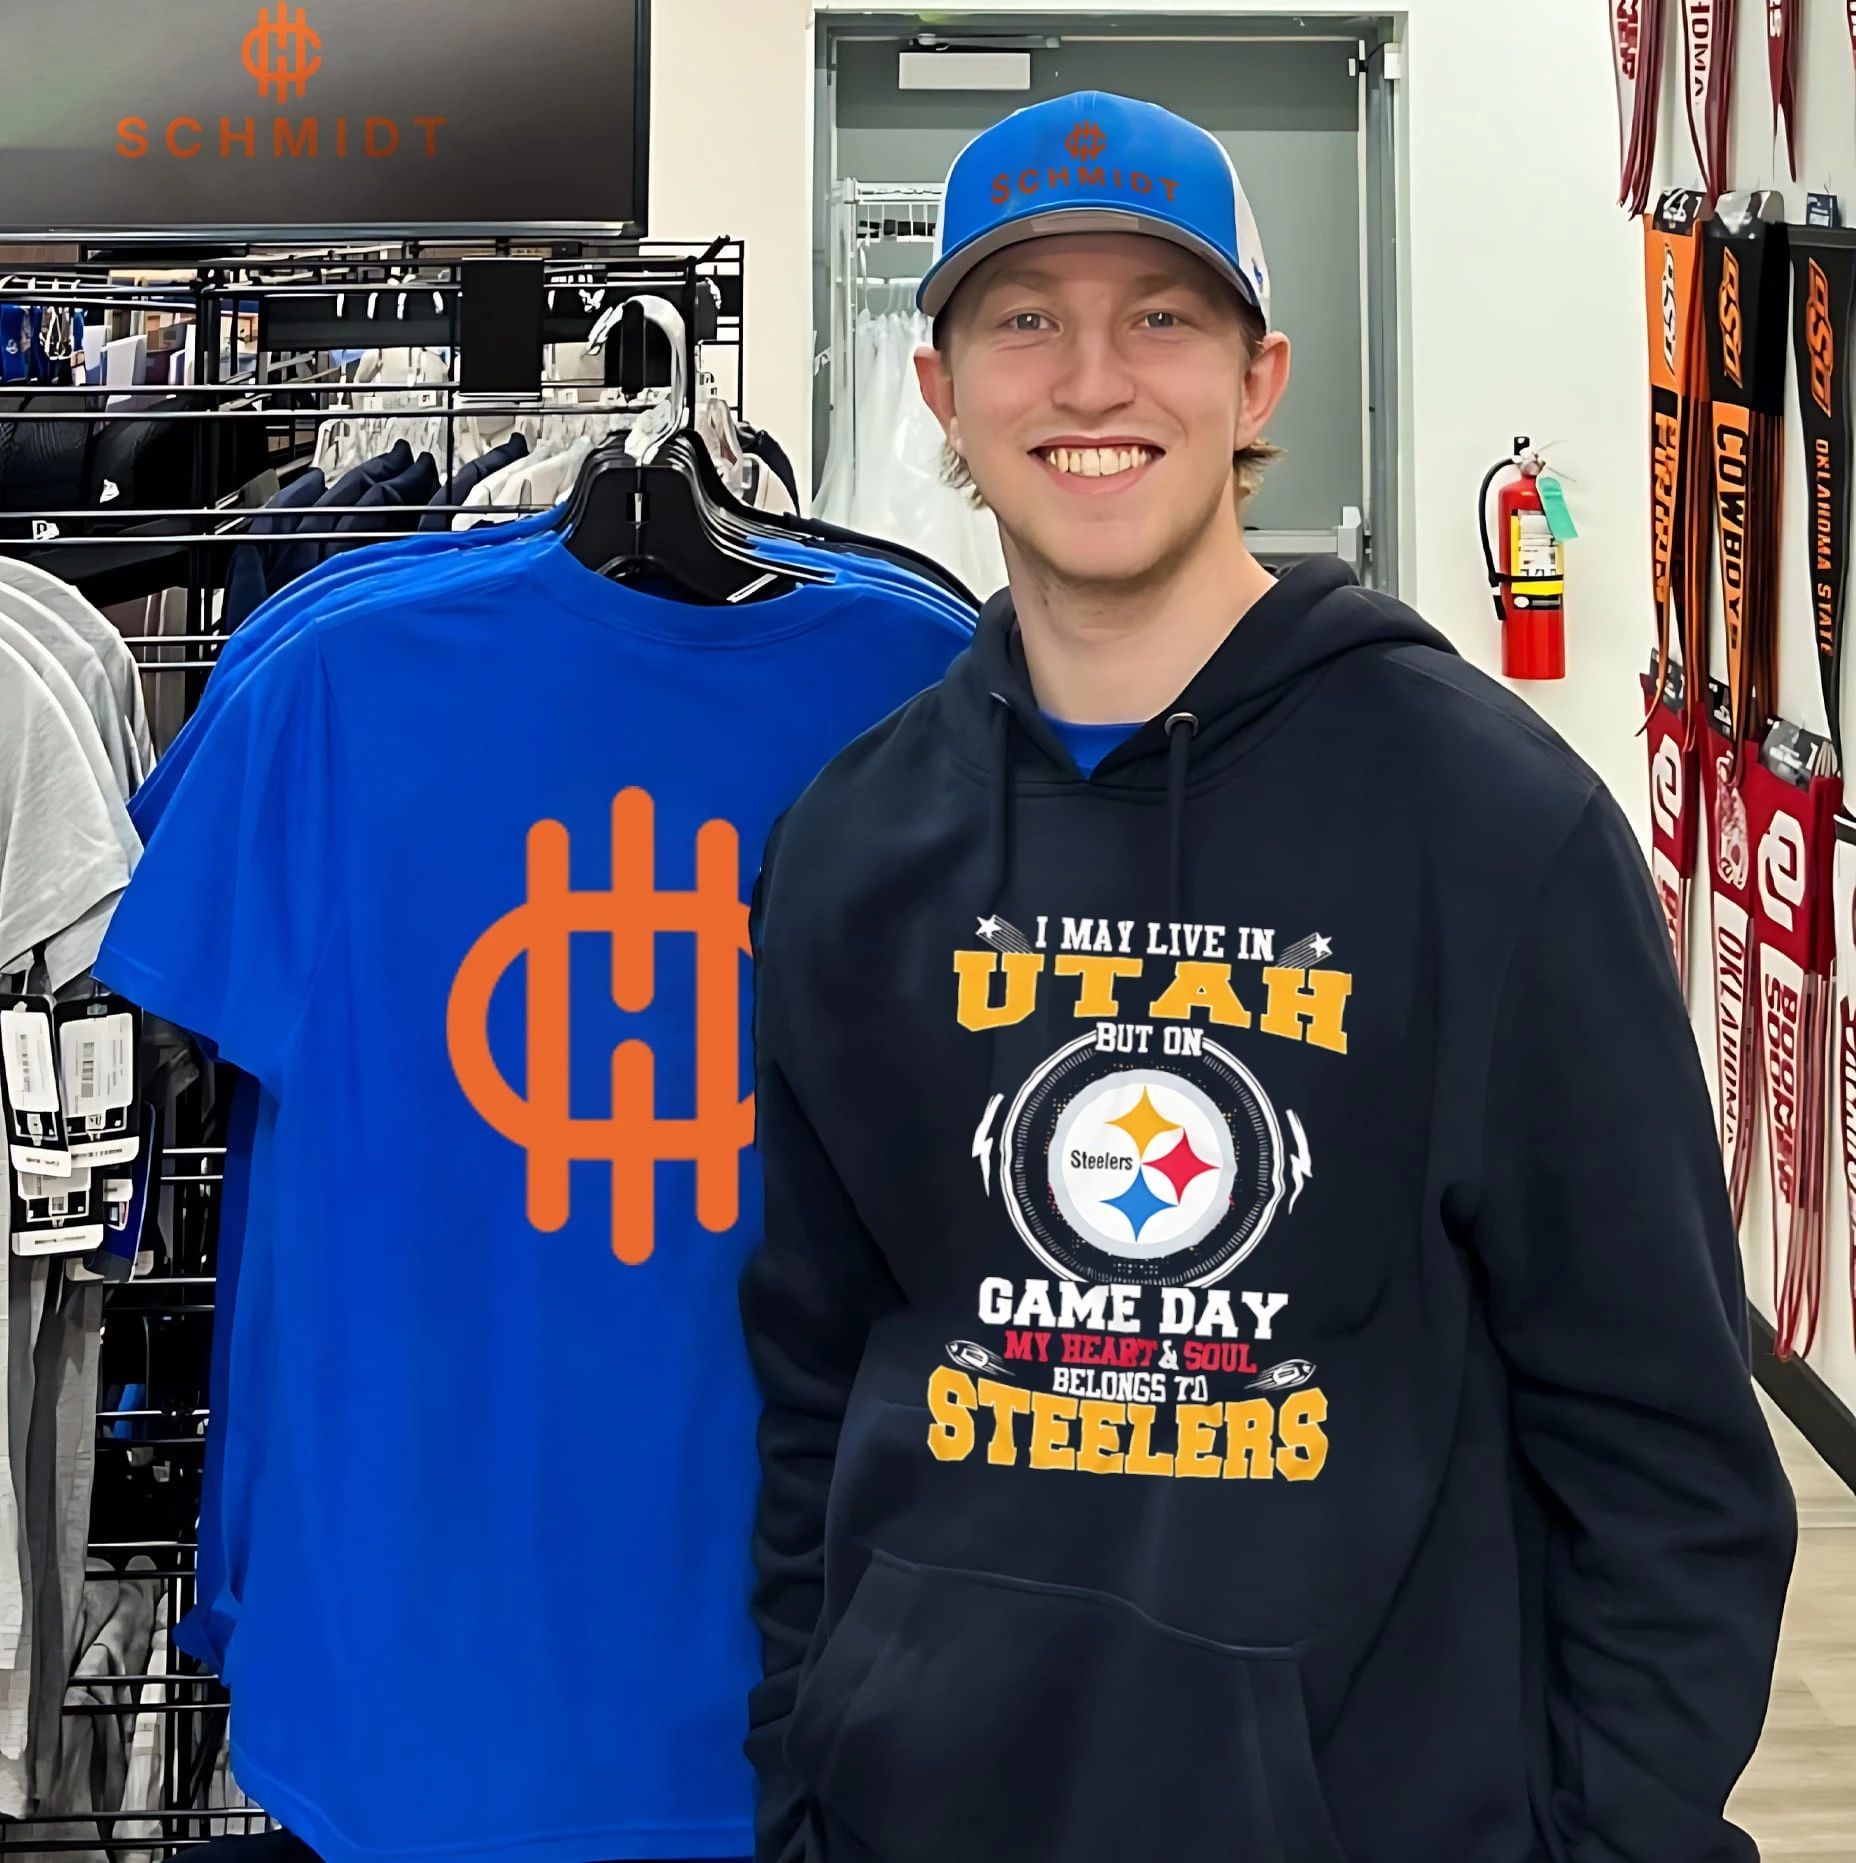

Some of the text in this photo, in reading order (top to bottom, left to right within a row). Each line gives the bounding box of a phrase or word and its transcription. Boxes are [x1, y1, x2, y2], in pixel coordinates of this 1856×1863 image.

[115, 115, 447, 160] SCHMIDT
[991, 166, 1180, 205] SCHMIDT
[1035, 915, 1275, 962] I MAY LIVE IN
[952, 949, 1353, 1055] UTAH
[1095, 1021, 1205, 1057] BUT ON
[1717, 926, 1745, 1144] OKLAHOMA
[1070, 1149, 1133, 1171] Steelers
[978, 1276, 1289, 1340] GAME DAY
[1004, 1330, 1258, 1374] MY HEART & SOUL
[1051, 1367, 1209, 1403] BELONGS TO
[926, 1364, 1330, 1483] STEELERS
